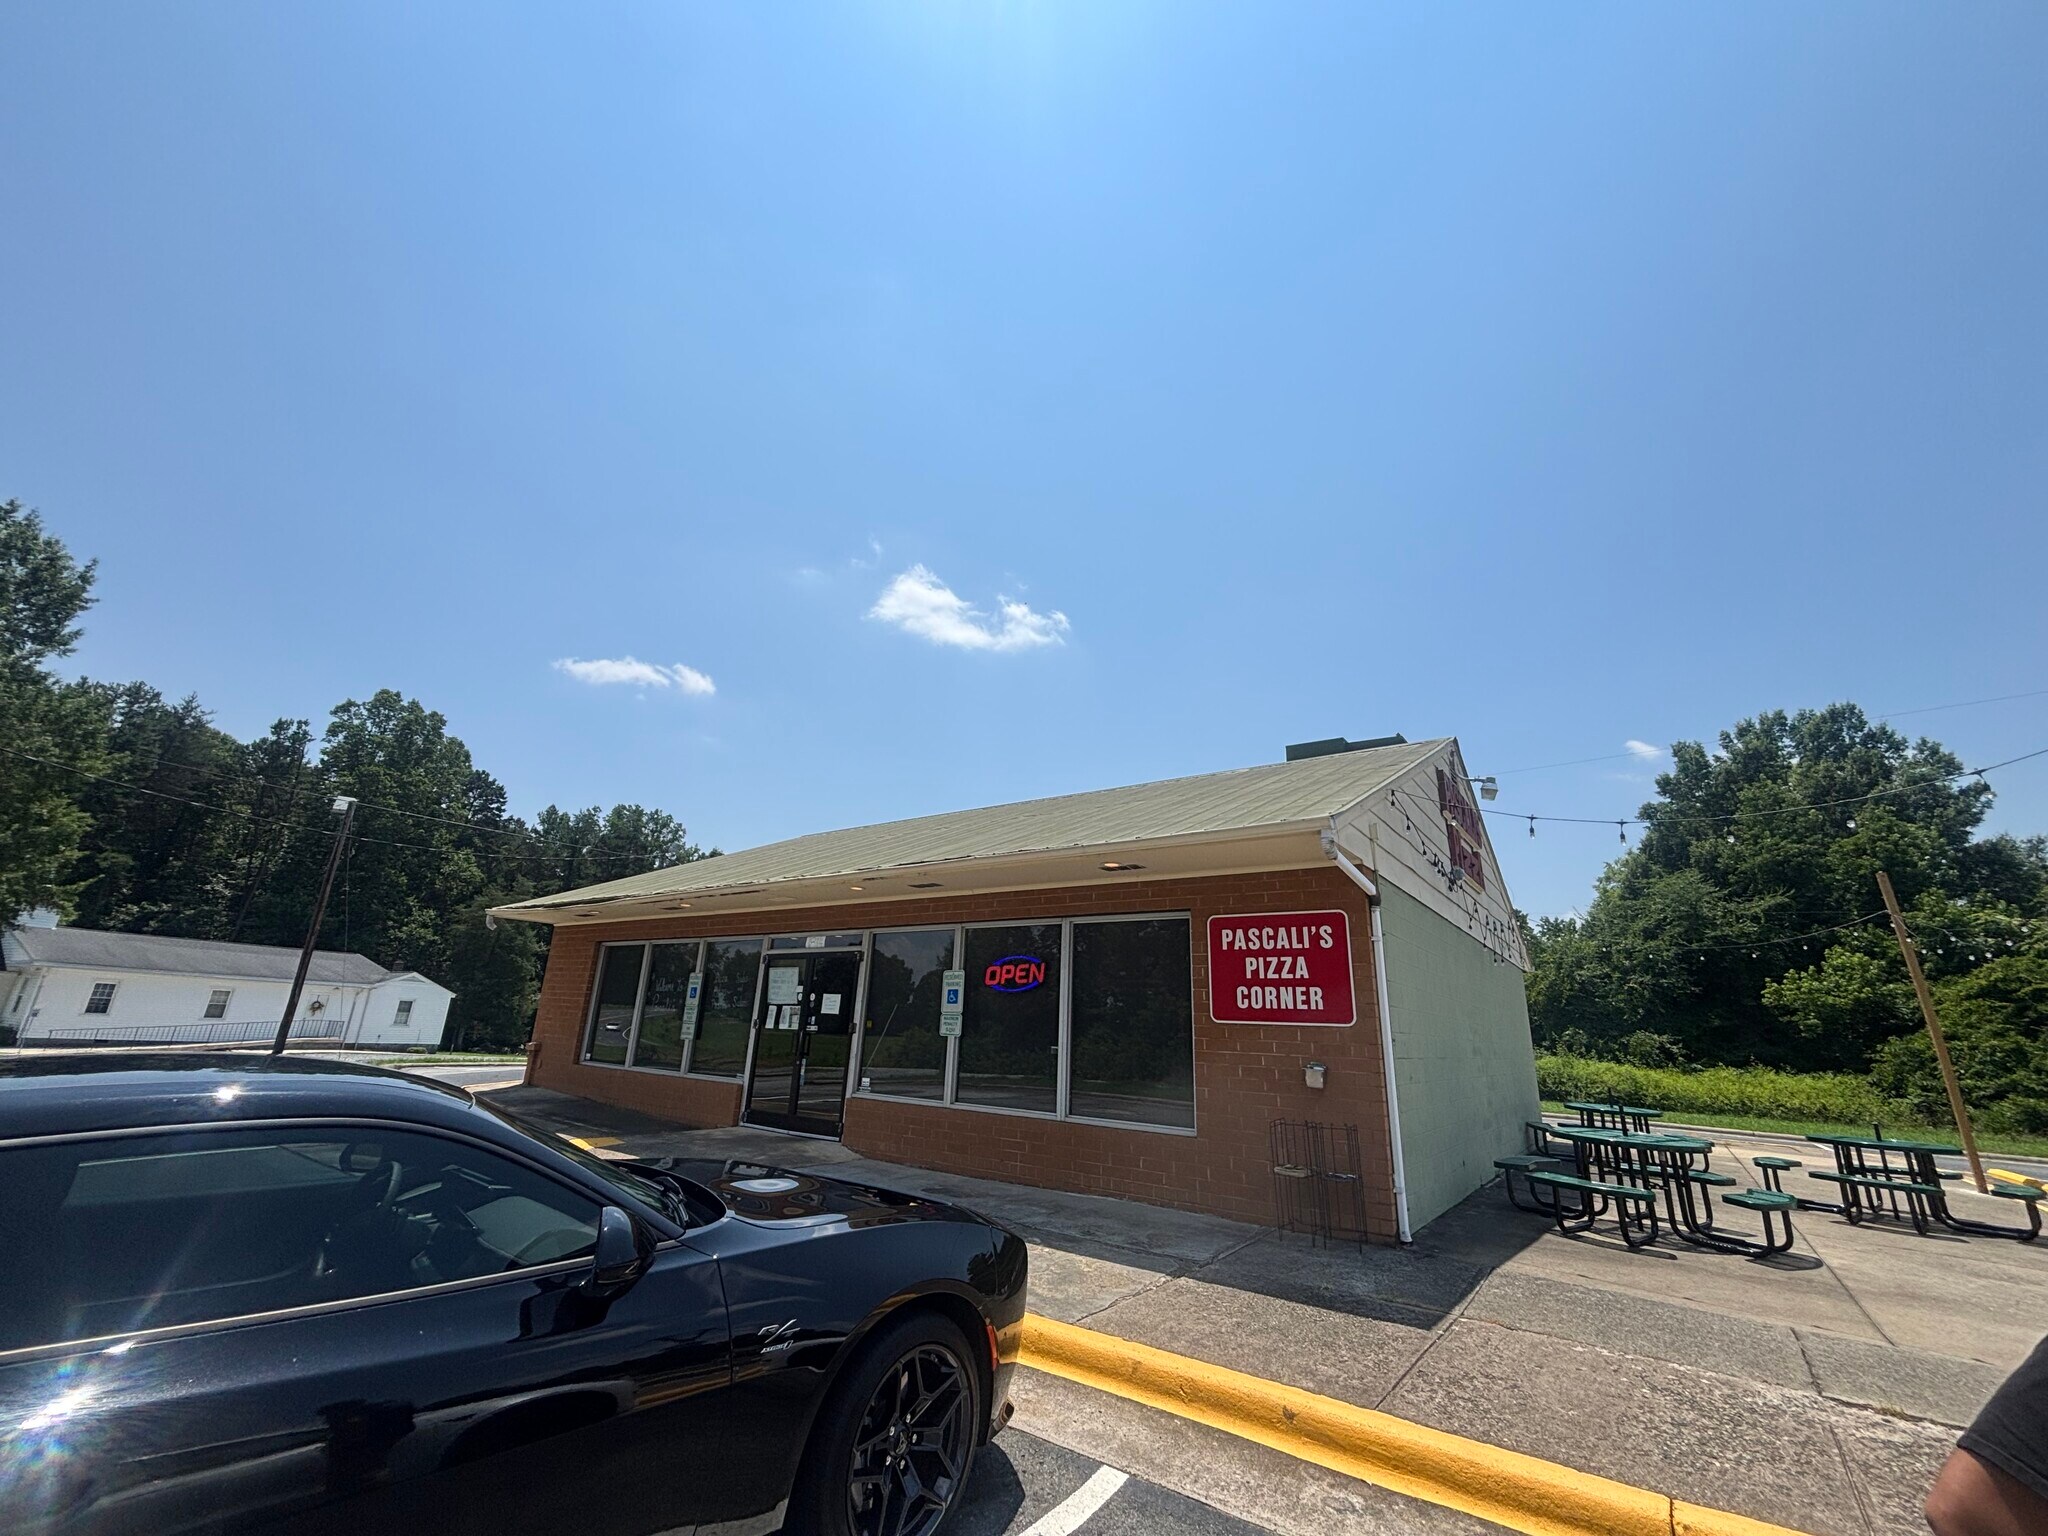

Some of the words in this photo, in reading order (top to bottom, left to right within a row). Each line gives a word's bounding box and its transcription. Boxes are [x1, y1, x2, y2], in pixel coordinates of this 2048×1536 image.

[1221, 925, 1334, 950] PASCALI'S
[985, 962, 1046, 986] OPEN
[1245, 956, 1310, 979] PIZZA
[1236, 986, 1324, 1010] CORNER
